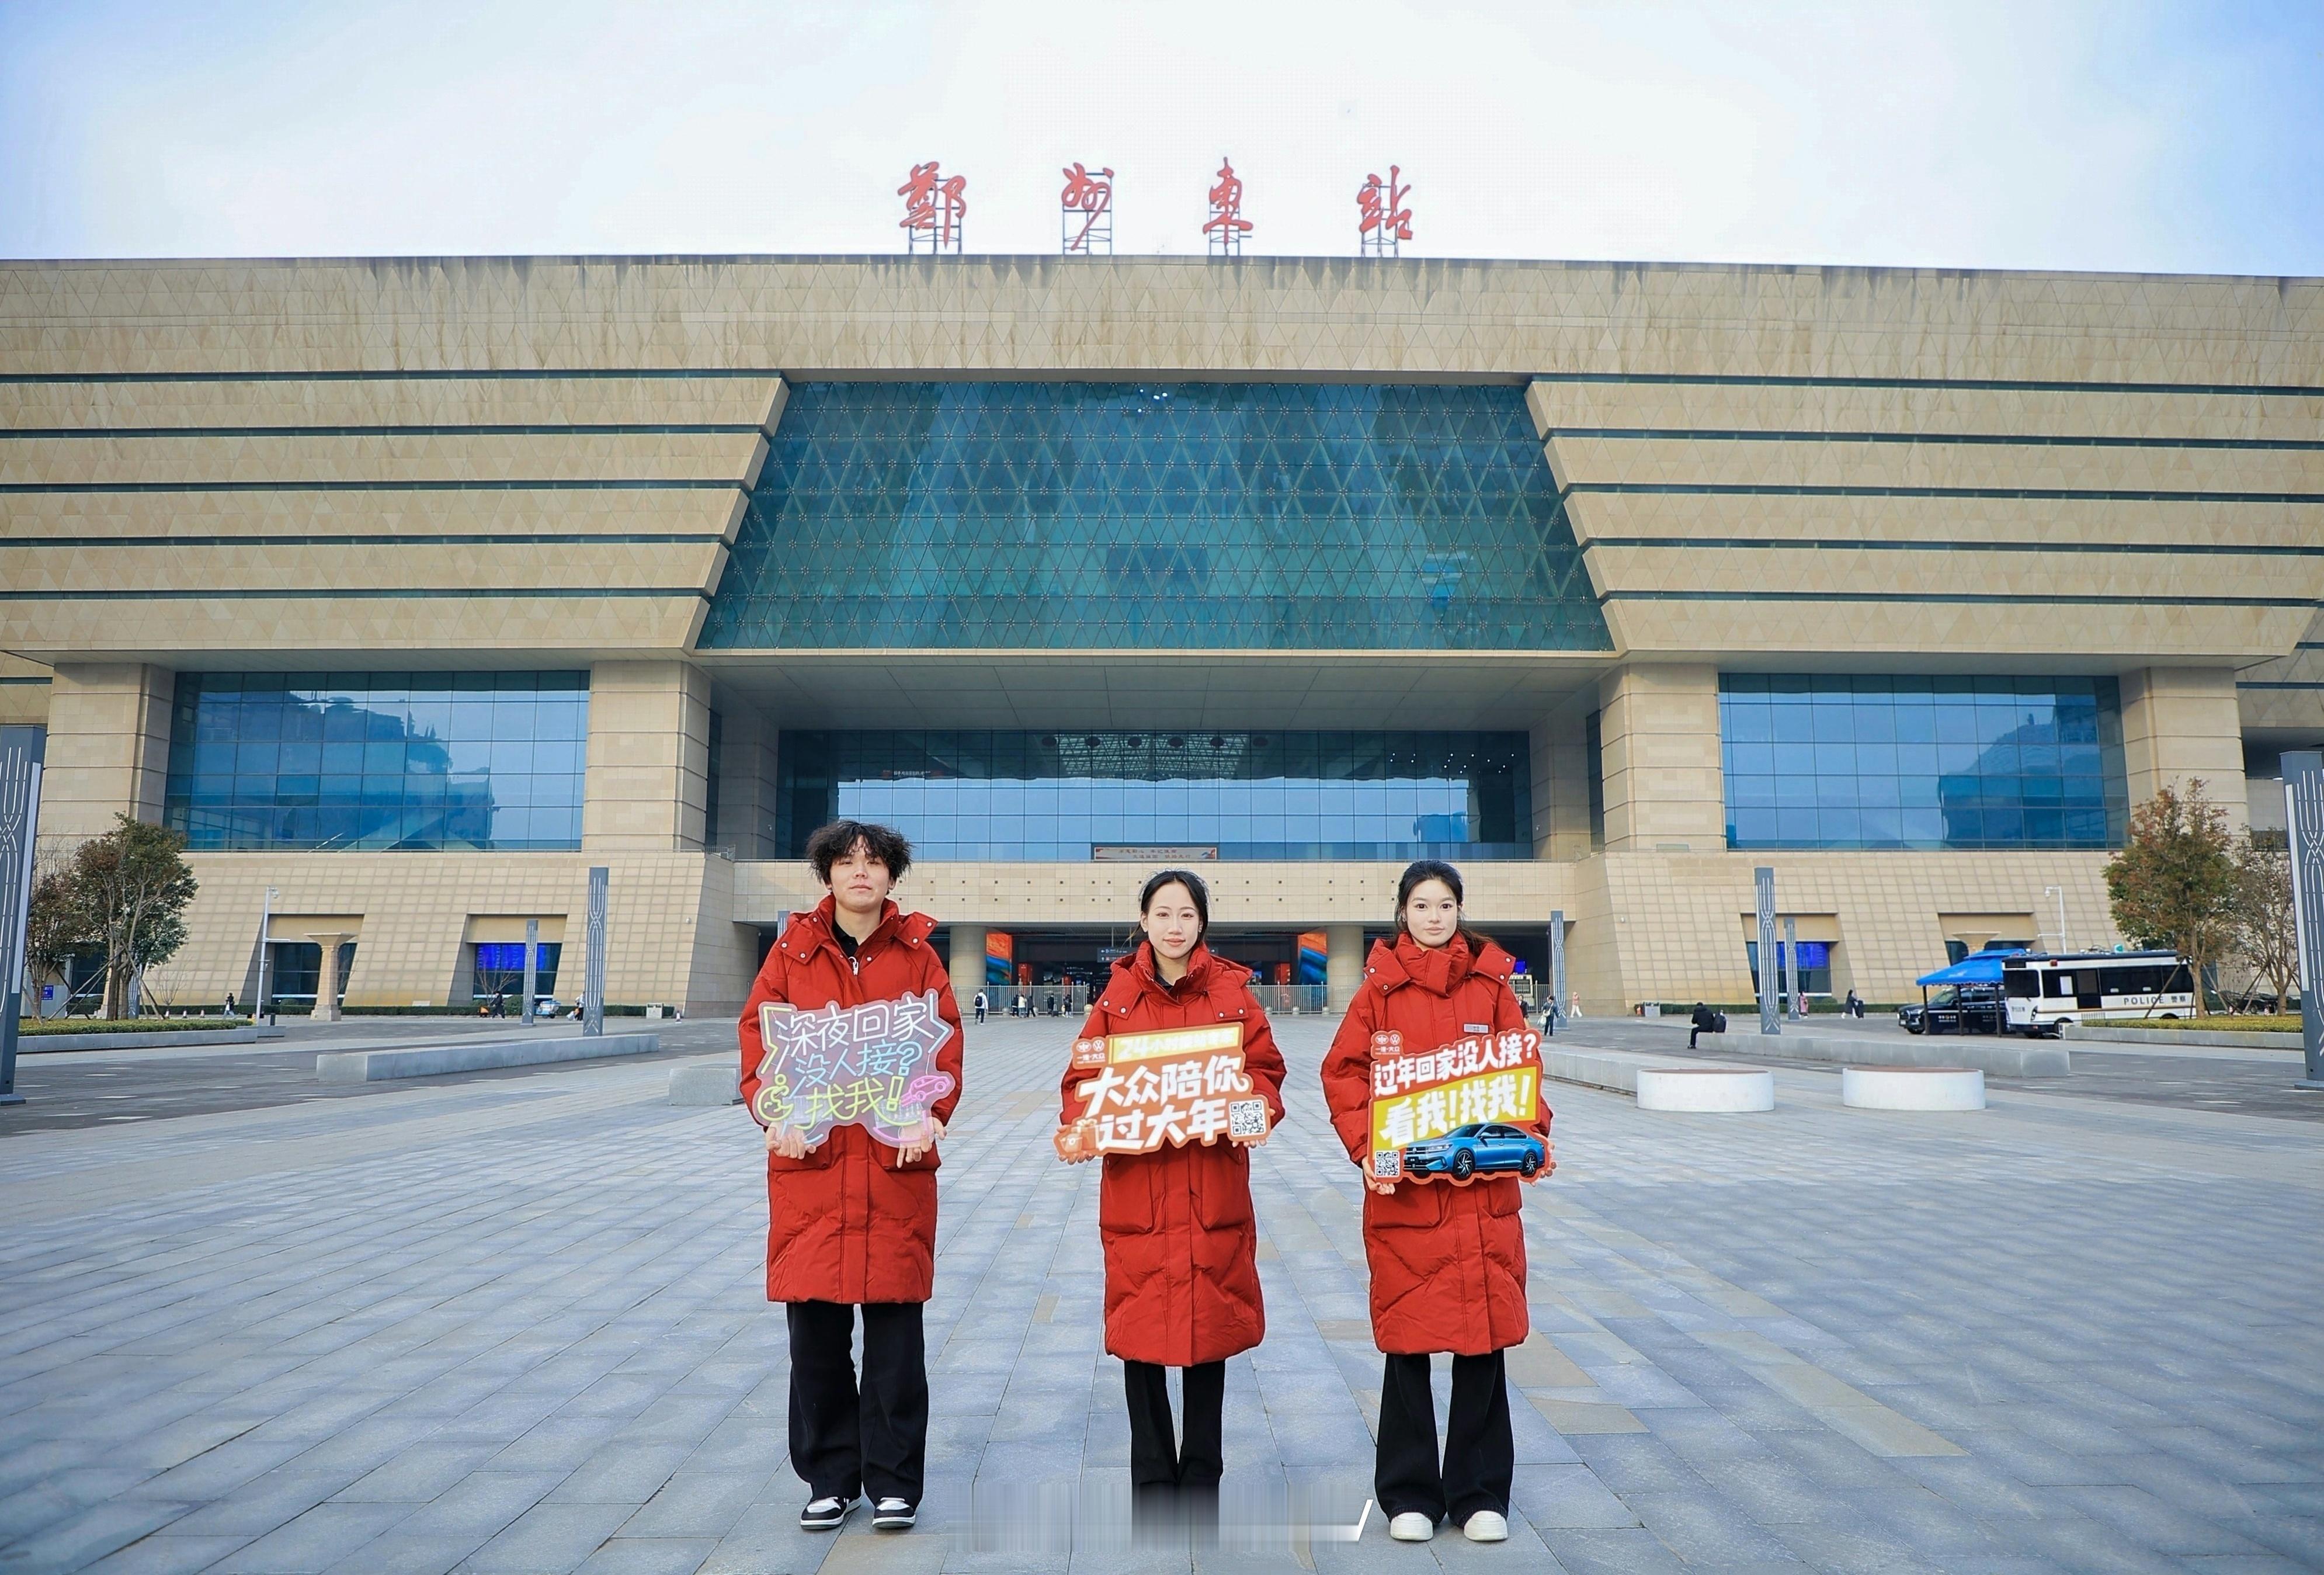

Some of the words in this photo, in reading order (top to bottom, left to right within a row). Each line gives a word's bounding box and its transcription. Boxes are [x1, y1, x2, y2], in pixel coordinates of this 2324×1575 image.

[774, 995, 935, 1074] 深夜回家
[1374, 1033, 1537, 1097] 过年回家没人接?
[790, 1039, 923, 1099] 没人接?
[1079, 1055, 1249, 1118] 大众陪你
[794, 1076, 918, 1130] 找我!
[1096, 1098, 1228, 1151] 过大年
[1379, 1074, 1530, 1149] 看我!找我!
